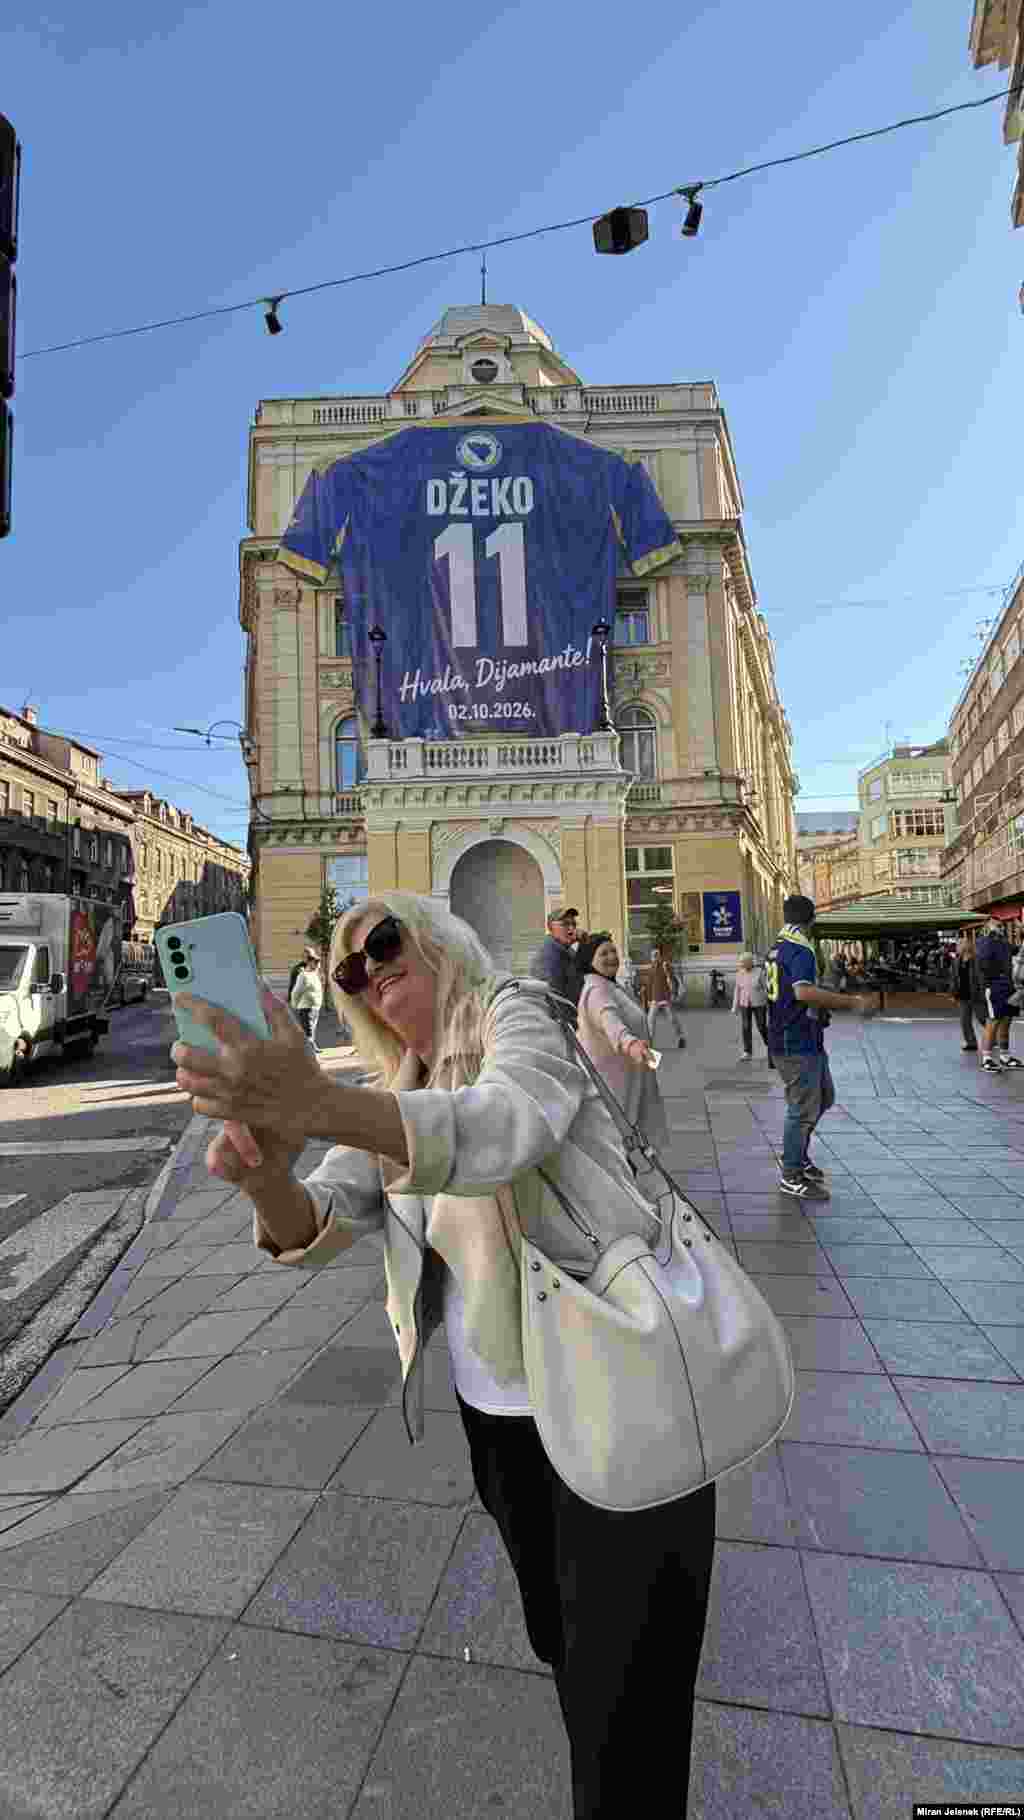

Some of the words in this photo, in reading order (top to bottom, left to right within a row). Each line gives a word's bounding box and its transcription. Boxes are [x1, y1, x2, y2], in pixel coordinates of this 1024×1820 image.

[426, 471, 535, 516] DŽEKO
[433, 522, 529, 648] 11
[399, 667, 470, 704] Hvala,
[474, 635, 593, 693] Dijamante!
[448, 701, 538, 720] 02.10.2026.
